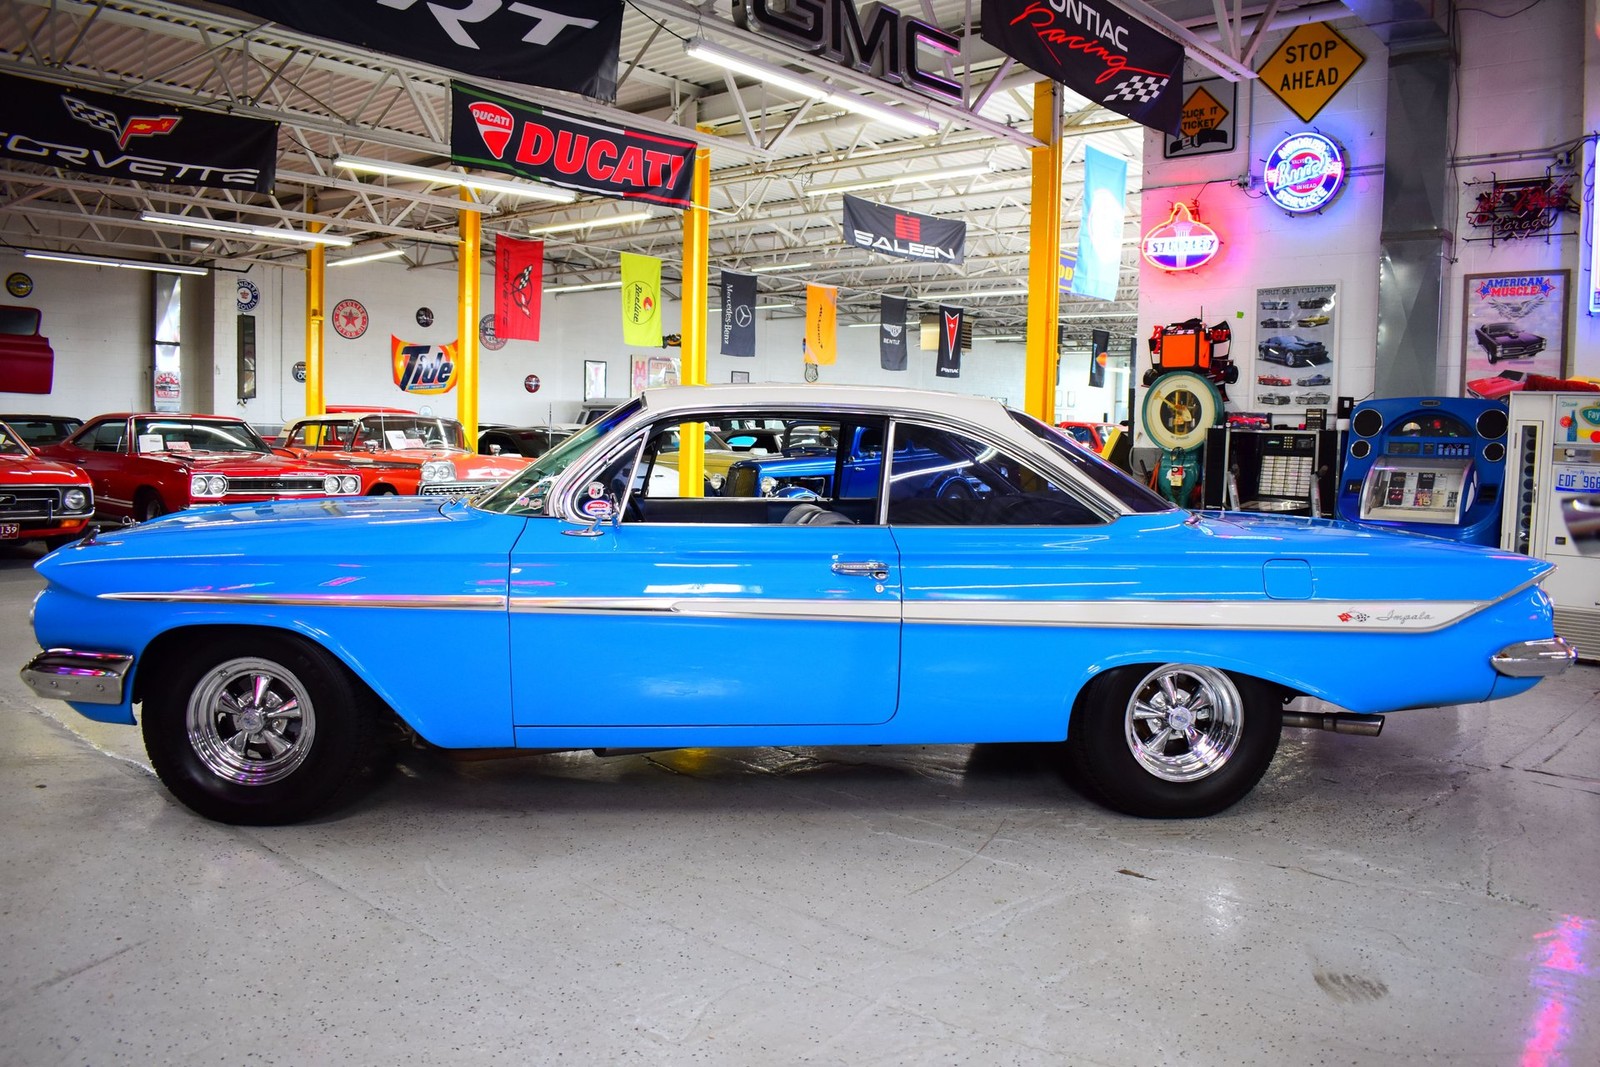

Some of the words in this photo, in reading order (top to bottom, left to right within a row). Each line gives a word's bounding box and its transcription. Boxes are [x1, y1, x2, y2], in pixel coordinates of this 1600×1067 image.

[1009, 1, 1171, 85] Racing
[1285, 39, 1338, 64] STOP
[732, 0, 964, 106] GMC
[1280, 67, 1339, 92] AHEAD
[472, 108, 511, 127] DUCATI
[1210, 106, 1218, 115] IT
[1182, 118, 1215, 129] TICKET
[515, 121, 685, 191] DUCATI
[854, 230, 956, 260] SALEEN
[1487, 276, 1544, 288] AMERICAN
[1491, 286, 1539, 297] MUSCLE
[1257, 289, 1280, 297] SPIRIT
[400, 345, 453, 391] Tide
[1558, 474, 1577, 487] EDF
[1375, 609, 1434, 624] Impala
